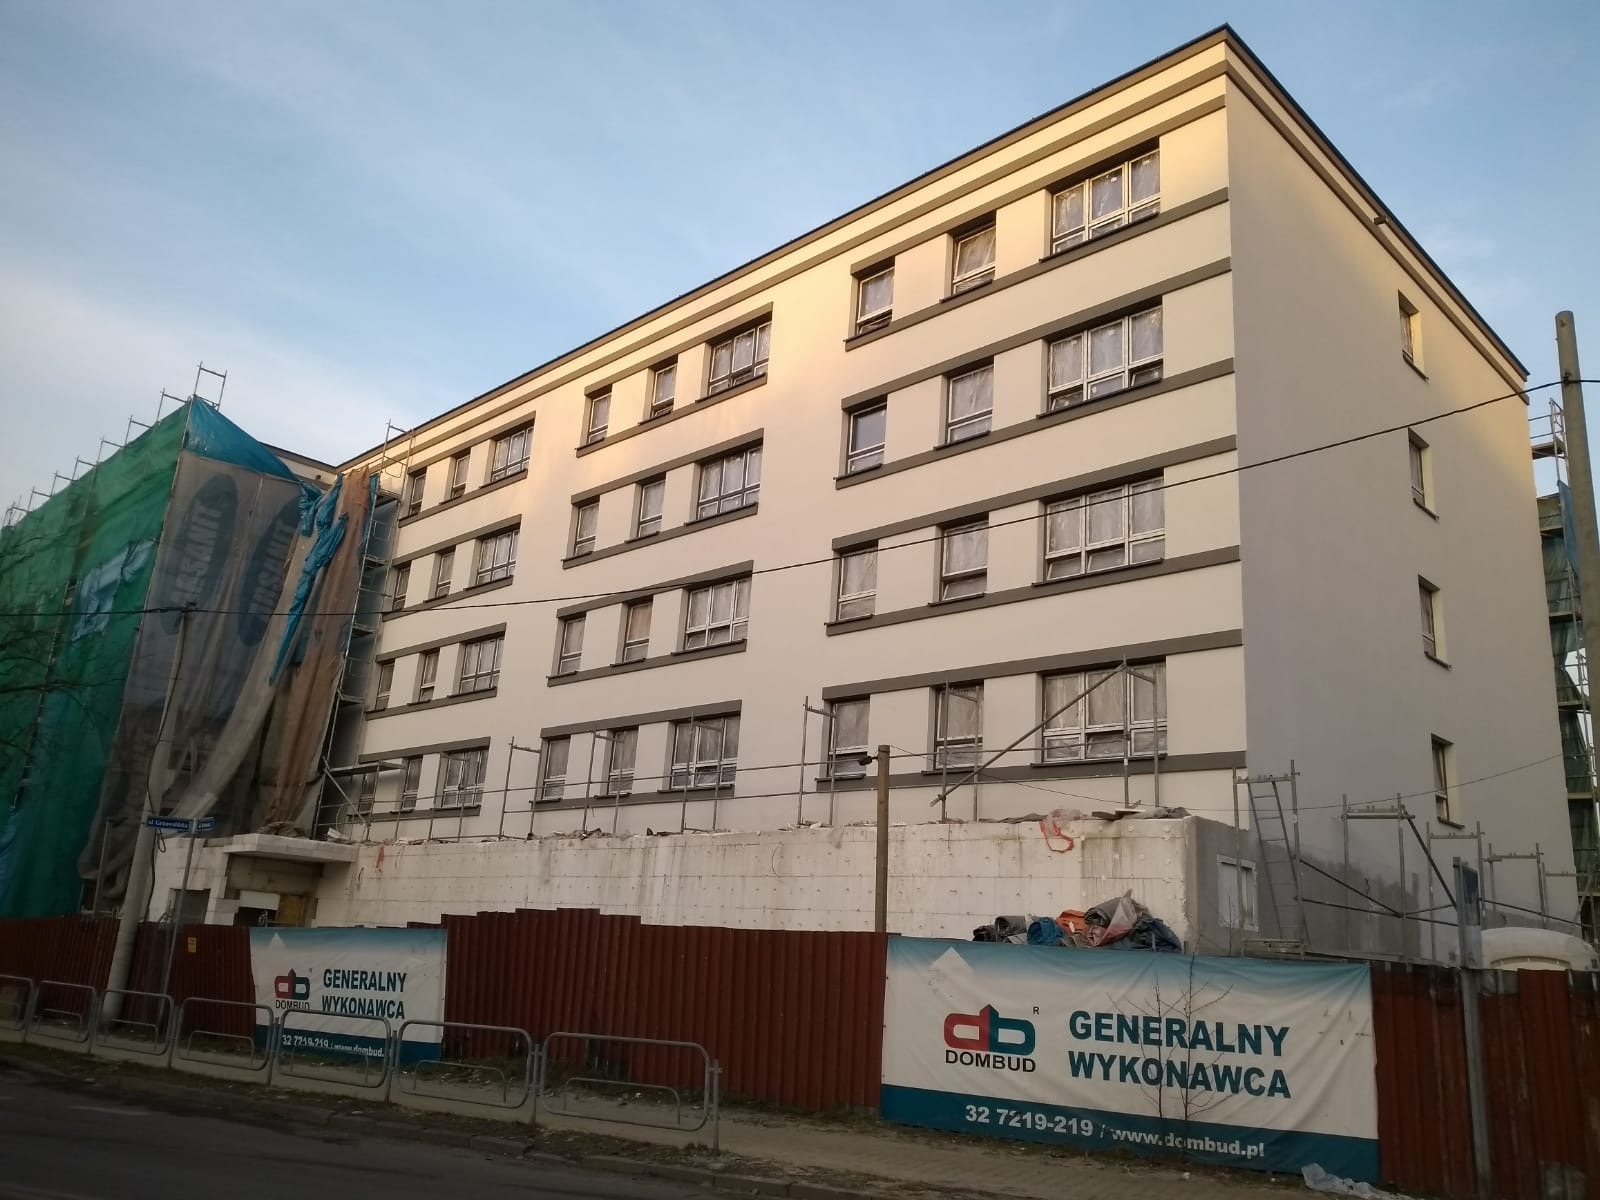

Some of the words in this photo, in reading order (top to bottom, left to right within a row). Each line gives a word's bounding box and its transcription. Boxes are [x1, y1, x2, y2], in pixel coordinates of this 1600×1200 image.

[323, 969, 407, 992] GENERALNY
[322, 995, 405, 1019] WYKONAWCA
[282, 1034, 292, 1046] 32
[1069, 1010, 1290, 1057] GENERALNY
[945, 1049, 1036, 1073] DOMBUD
[1069, 1051, 1292, 1098] WYKONAWCA
[966, 1104, 990, 1124] 32
[996, 1108, 1093, 1137] 7219-219
[1110, 1127, 1265, 1160] www.dombud.pl
